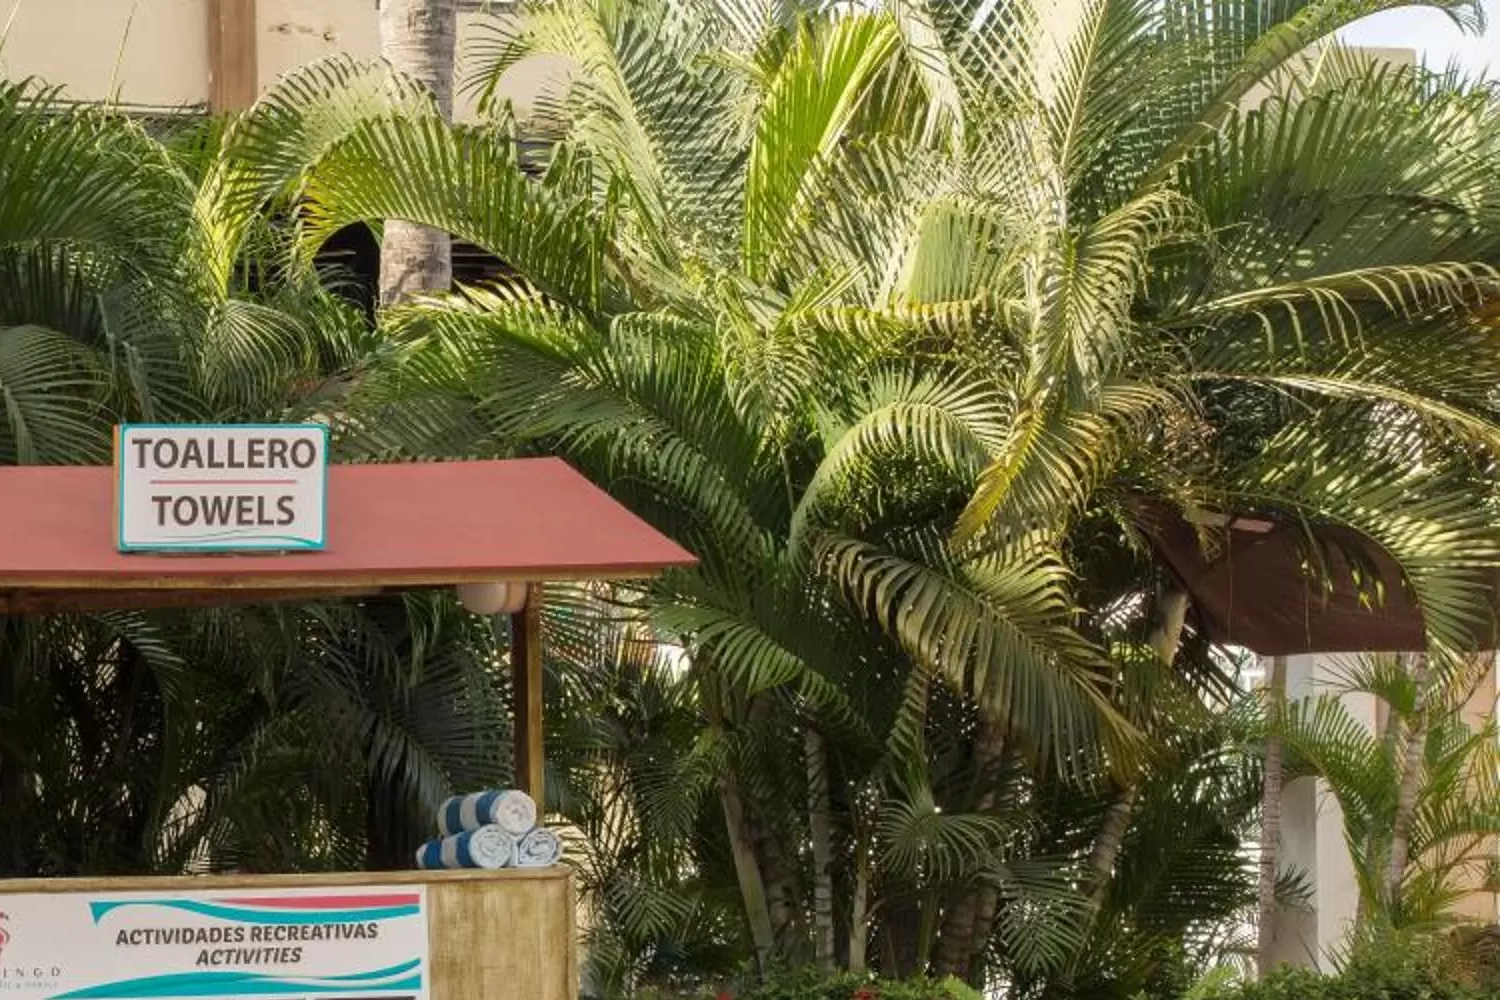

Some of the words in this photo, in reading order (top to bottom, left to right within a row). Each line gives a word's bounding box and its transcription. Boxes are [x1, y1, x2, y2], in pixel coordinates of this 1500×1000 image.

[131, 438, 317, 469] TOALLERO
[151, 495, 296, 526] TOWELS
[116, 926, 245, 945] ACTIVIDADES
[250, 922, 379, 942] RECREATIVAS
[196, 946, 303, 966] ACTIVITIES
